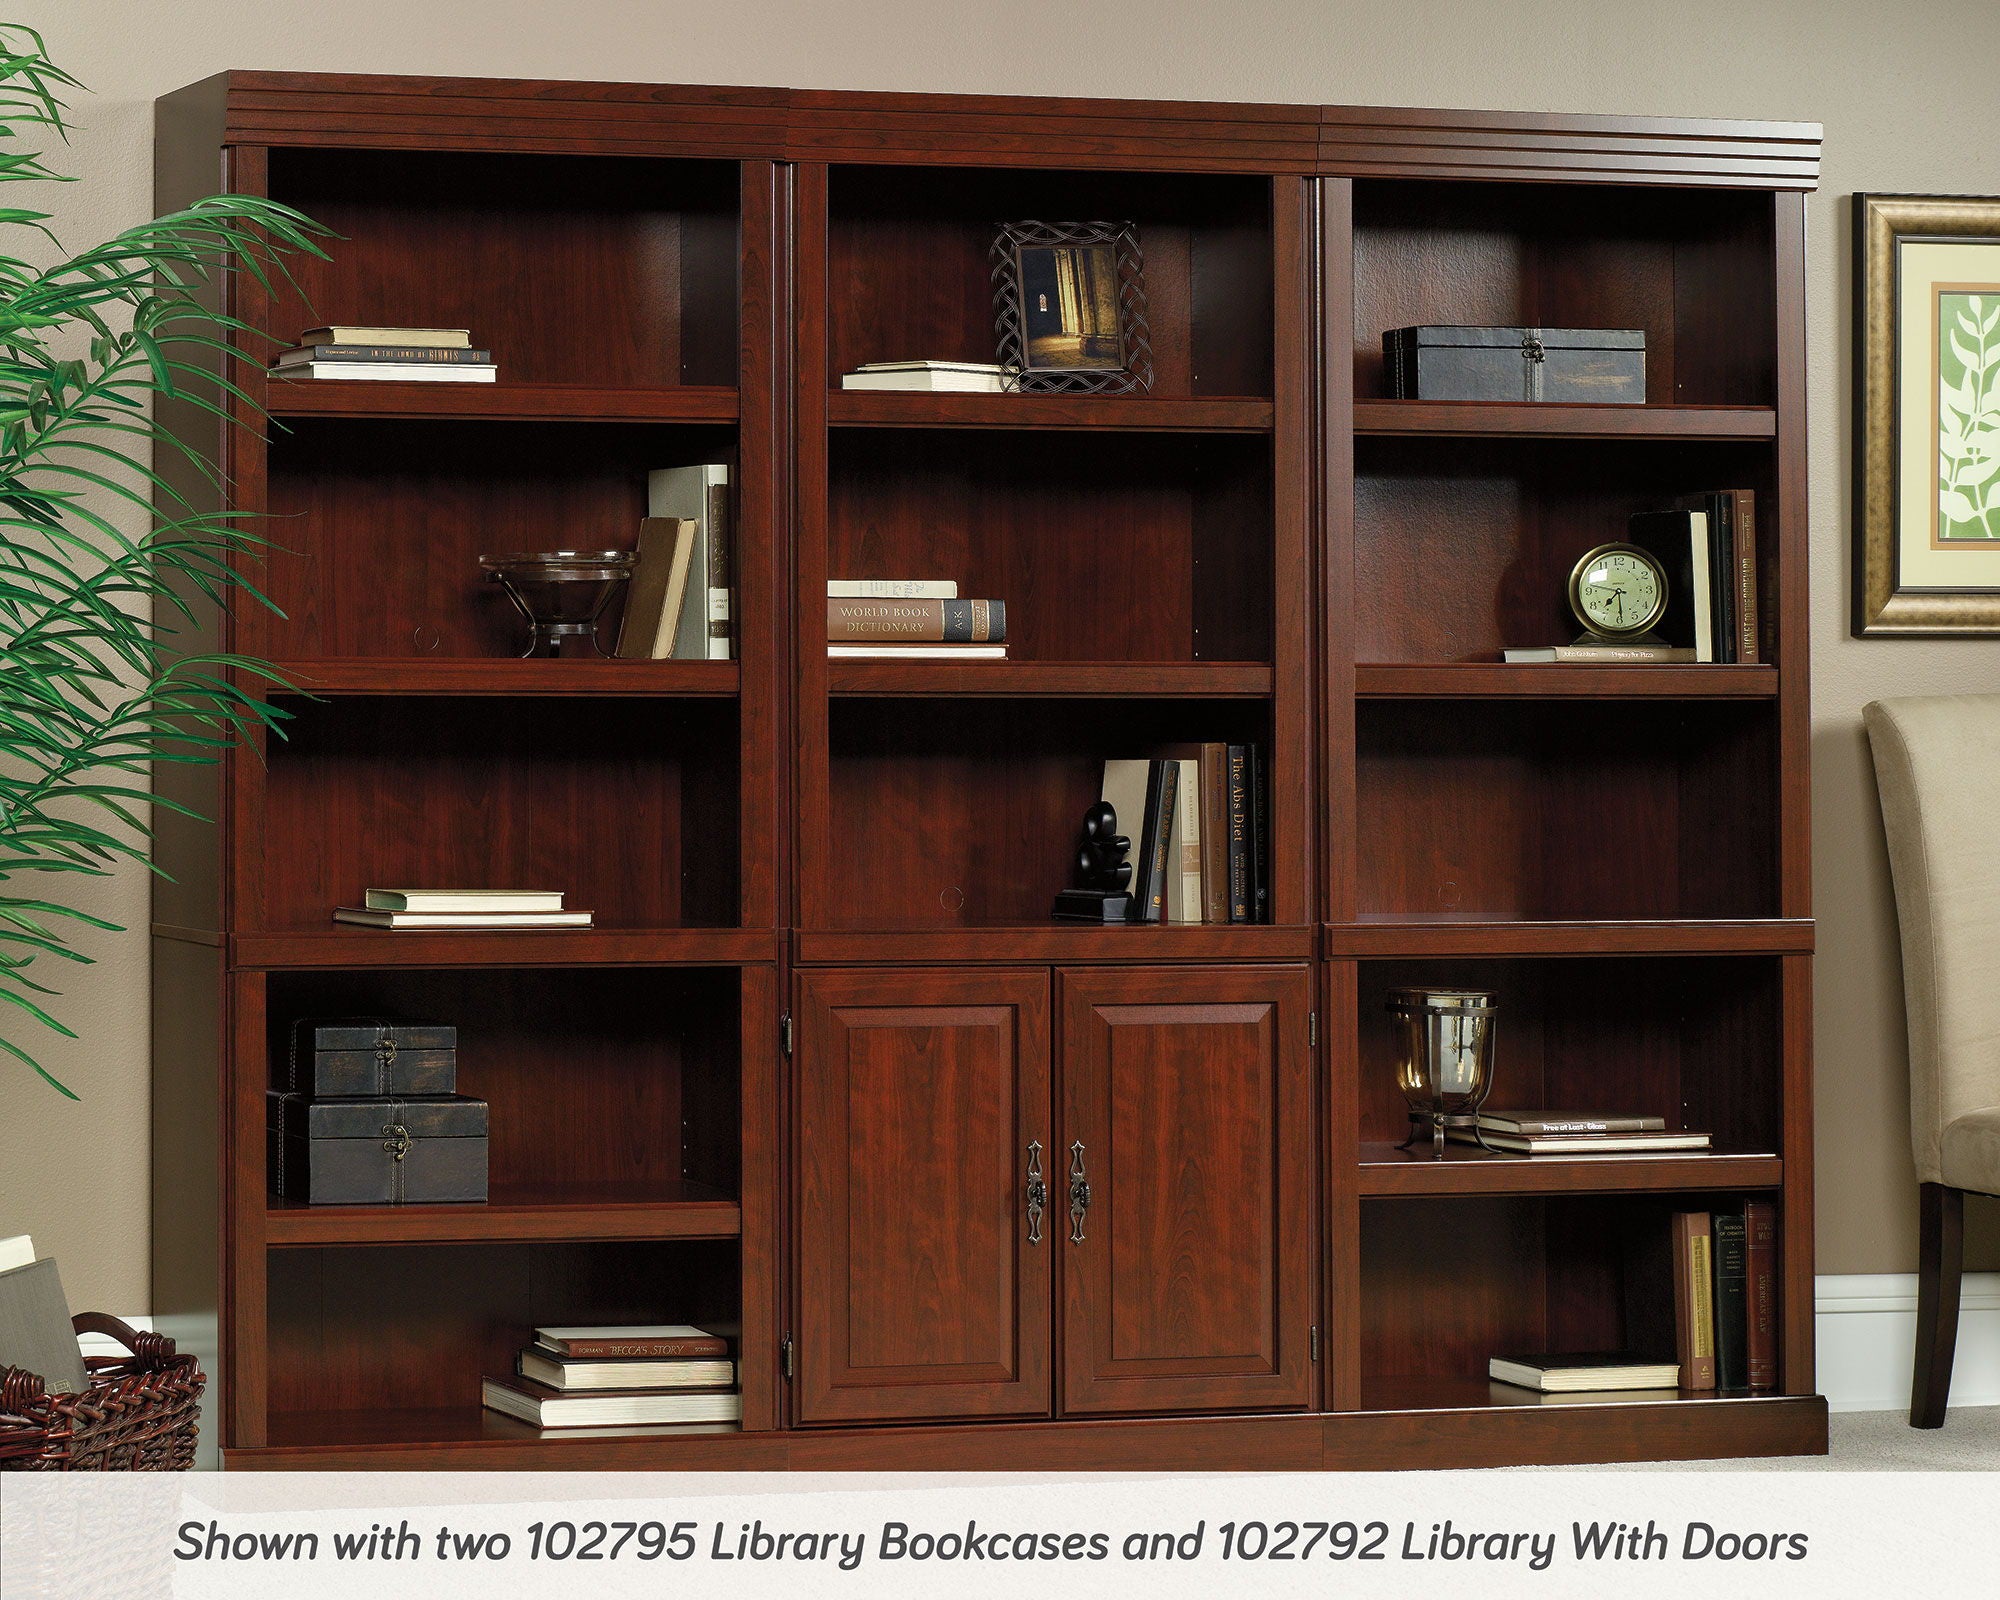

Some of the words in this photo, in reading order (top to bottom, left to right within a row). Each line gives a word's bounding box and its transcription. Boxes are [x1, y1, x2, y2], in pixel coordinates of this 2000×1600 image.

[1613, 557, 1625, 566] 12
[1632, 561, 1638, 570] 1
[1641, 570, 1649, 580] 2
[1585, 587, 1593, 596] 9
[1645, 586, 1653, 595] 3
[1589, 601, 1598, 611] 8
[1642, 601, 1649, 610] 4
[840, 607, 889, 617] WORLD
[893, 607, 930, 617] BOOK
[1631, 611, 1639, 621] 5
[1616, 615, 1624, 625] 6
[847, 622, 925, 632] DICTIONARY
[1744, 622, 1755, 649] TICKET
[1232, 756, 1244, 780] The
[1233, 785, 1244, 809] Abs
[1234, 814, 1245, 841] Diet
[1568, 1123, 1583, 1131] Last
[1586, 1122, 1606, 1130] Glass
[1759, 1274, 1767, 1314] AMERICAN
[1759, 1317, 1767, 1334] LAW
[610, 1344, 648, 1356] BECCA'S
[651, 1345, 685, 1355] STORY
